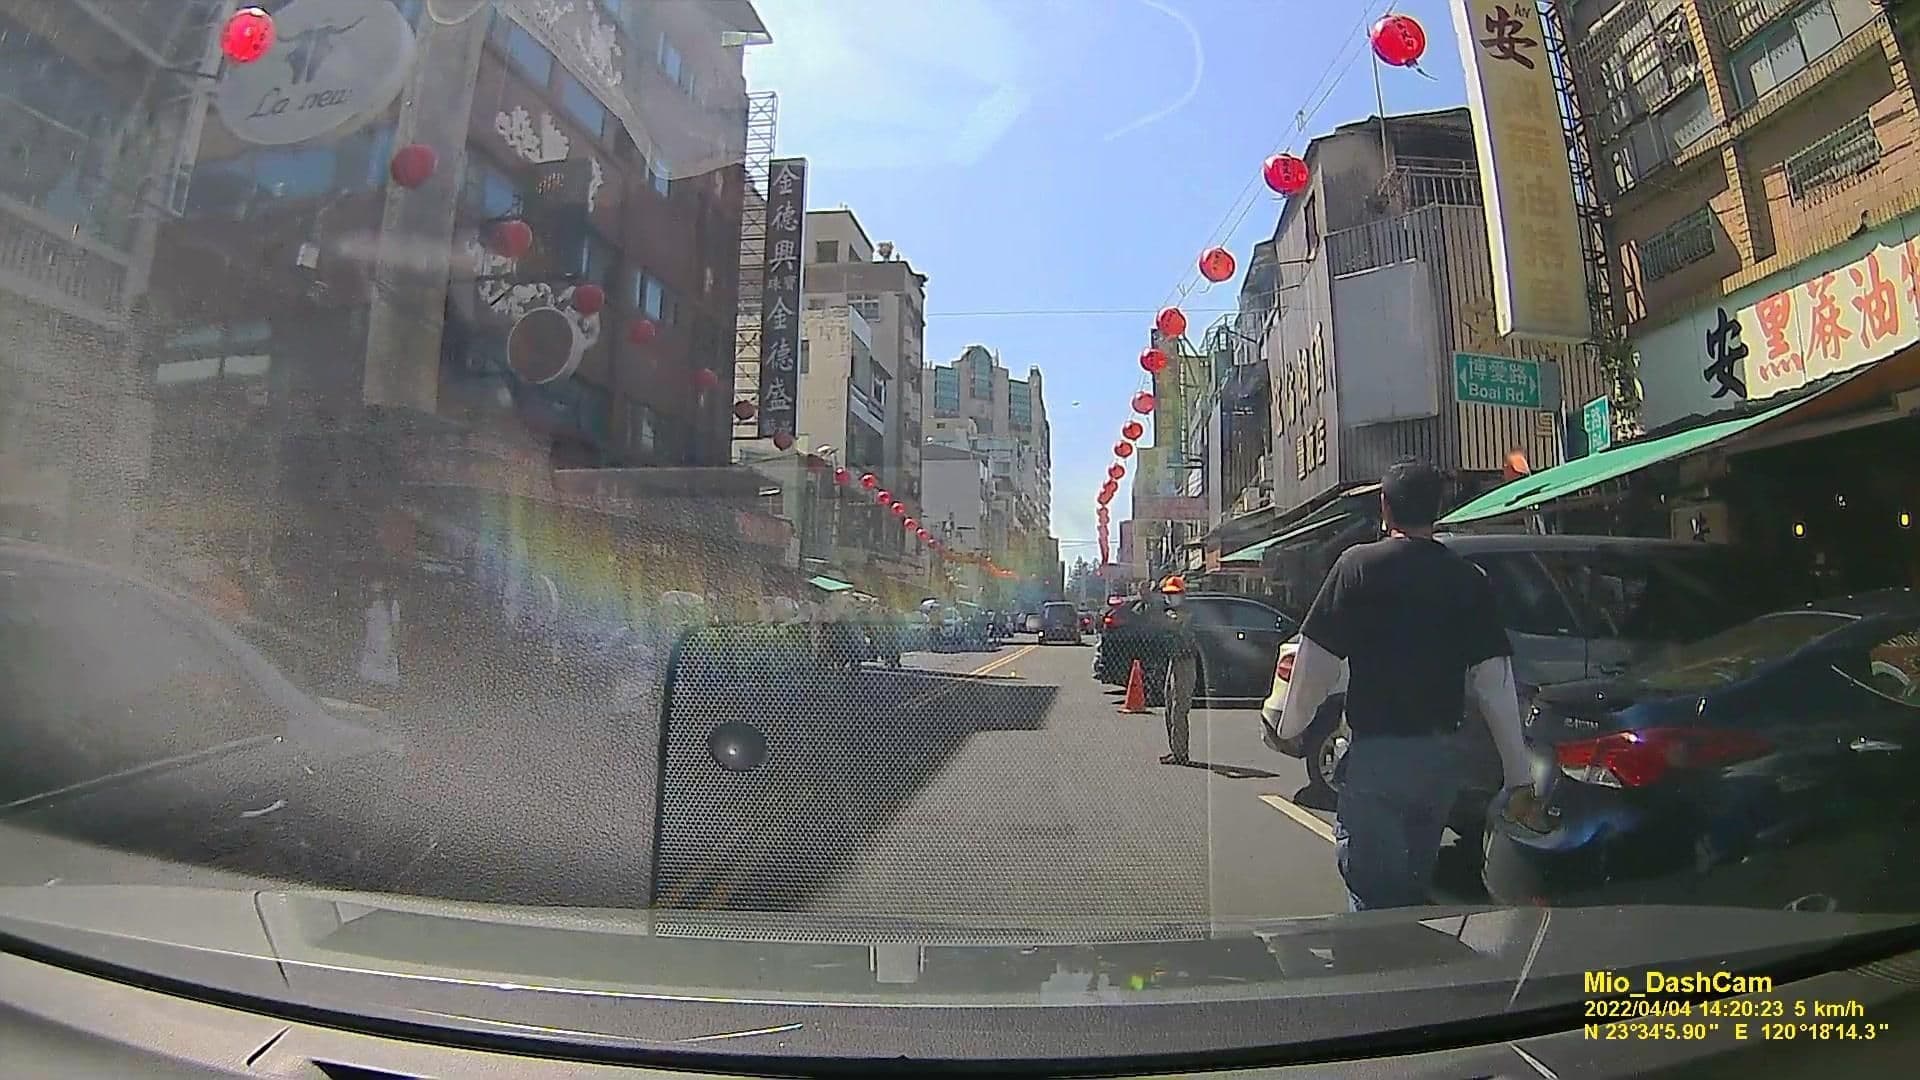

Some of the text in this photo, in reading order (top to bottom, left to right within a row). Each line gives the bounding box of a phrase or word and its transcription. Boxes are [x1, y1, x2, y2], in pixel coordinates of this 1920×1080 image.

[770, 164, 800, 273] 金德興
[763, 296, 794, 412] 金德盛
[1468, 357, 1528, 386] 博愛路
